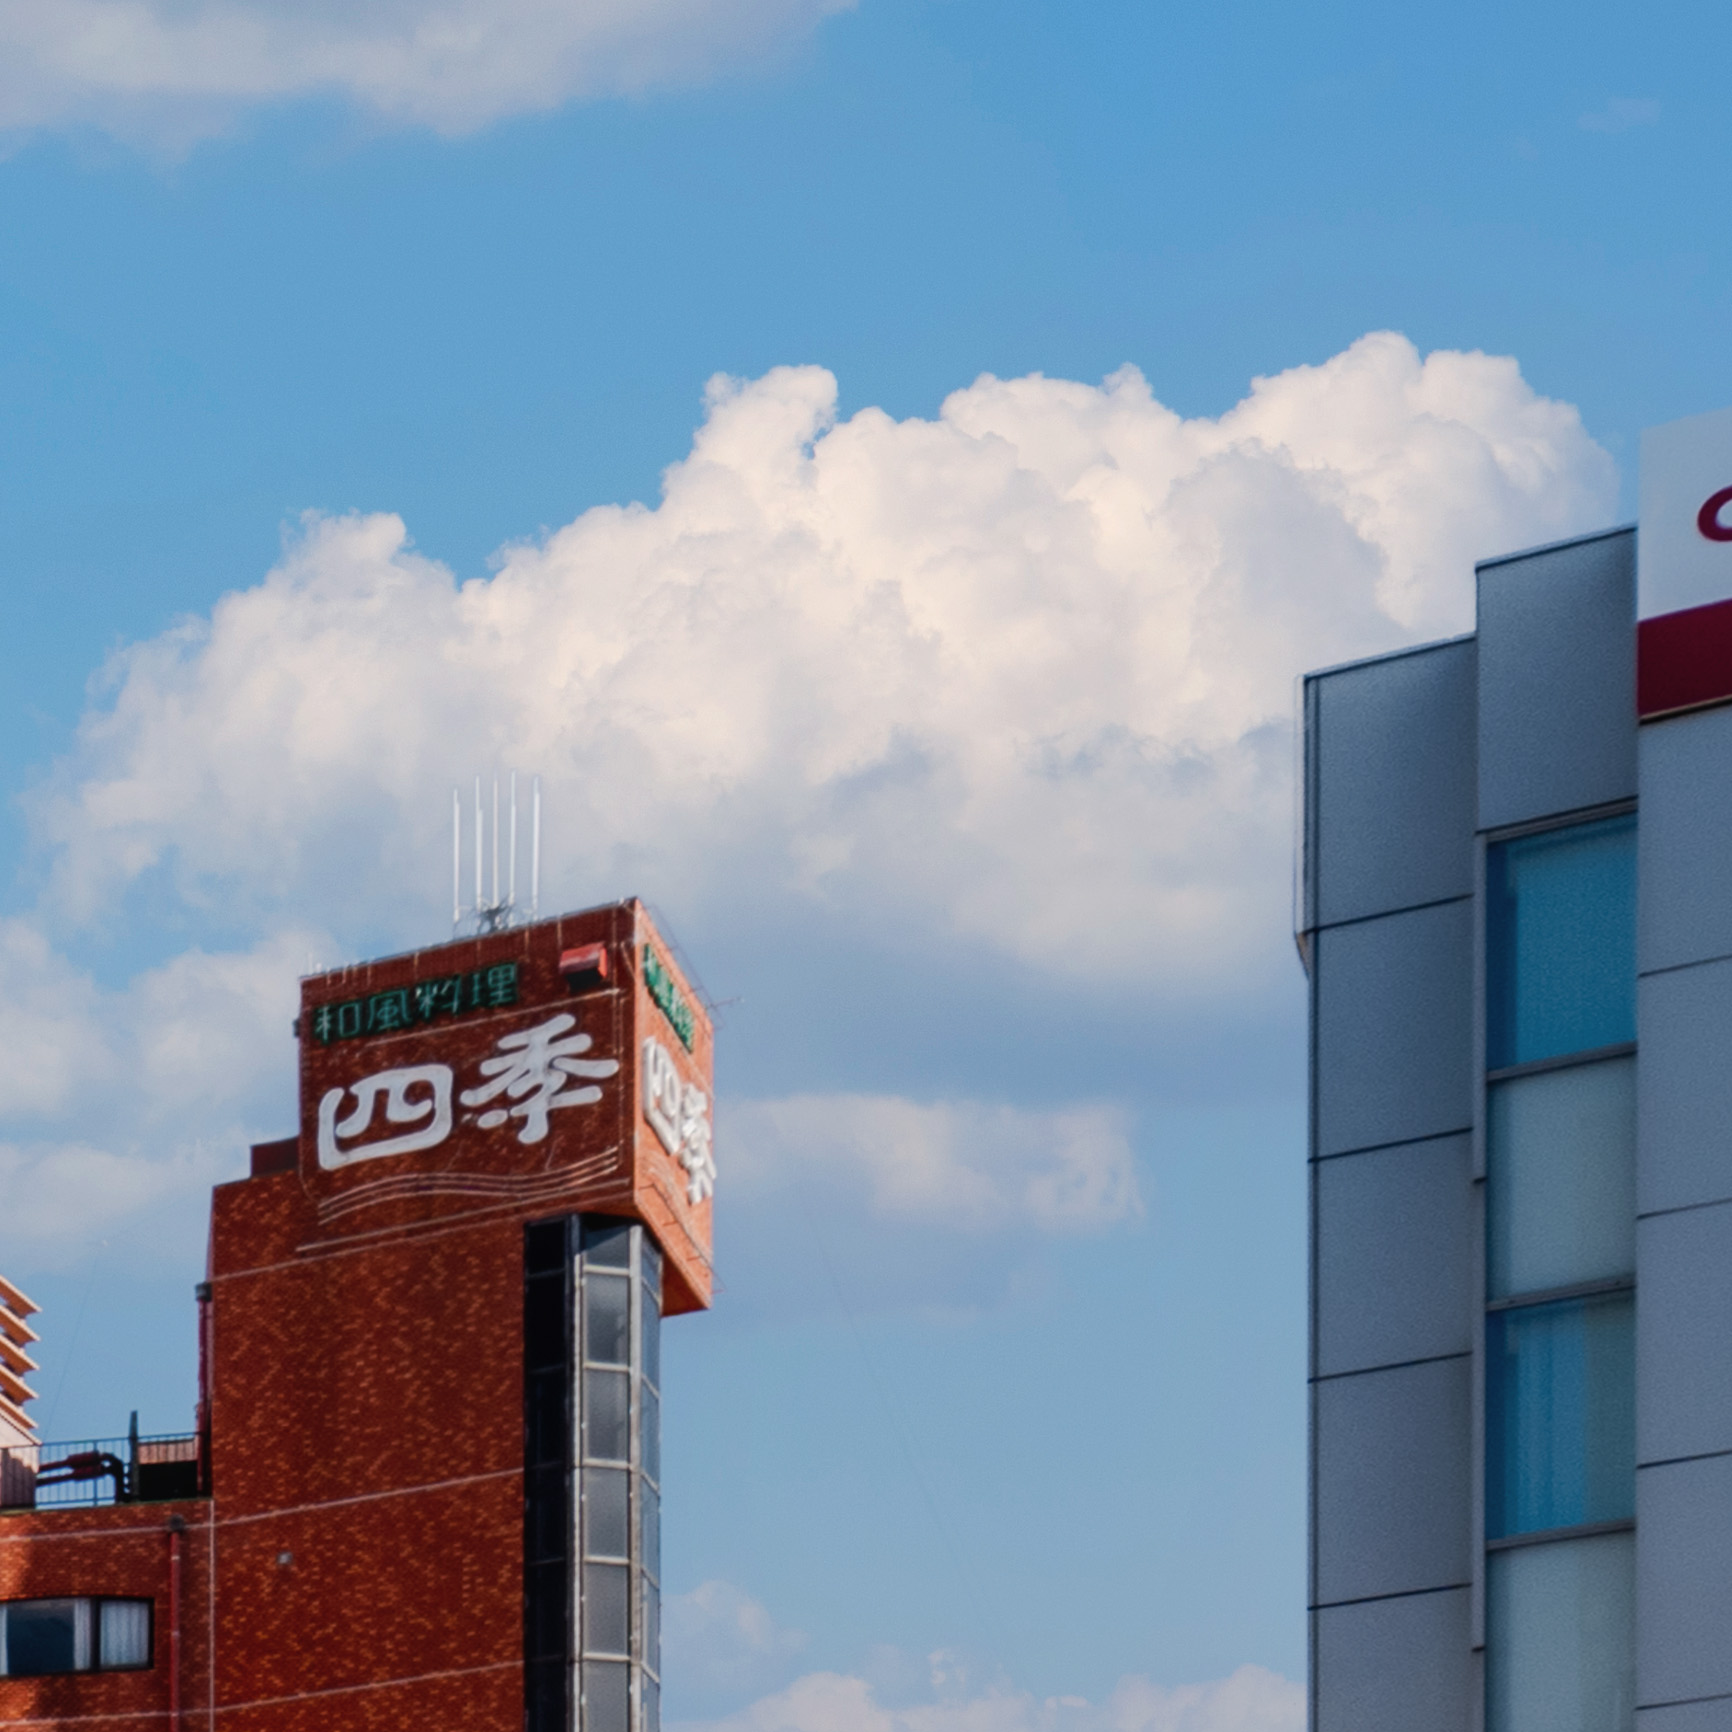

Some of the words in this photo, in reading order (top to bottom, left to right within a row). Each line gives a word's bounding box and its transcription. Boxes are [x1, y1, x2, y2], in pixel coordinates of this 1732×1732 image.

[314, 961, 519, 1044] 和風料理
[317, 1012, 620, 1171] 四季
